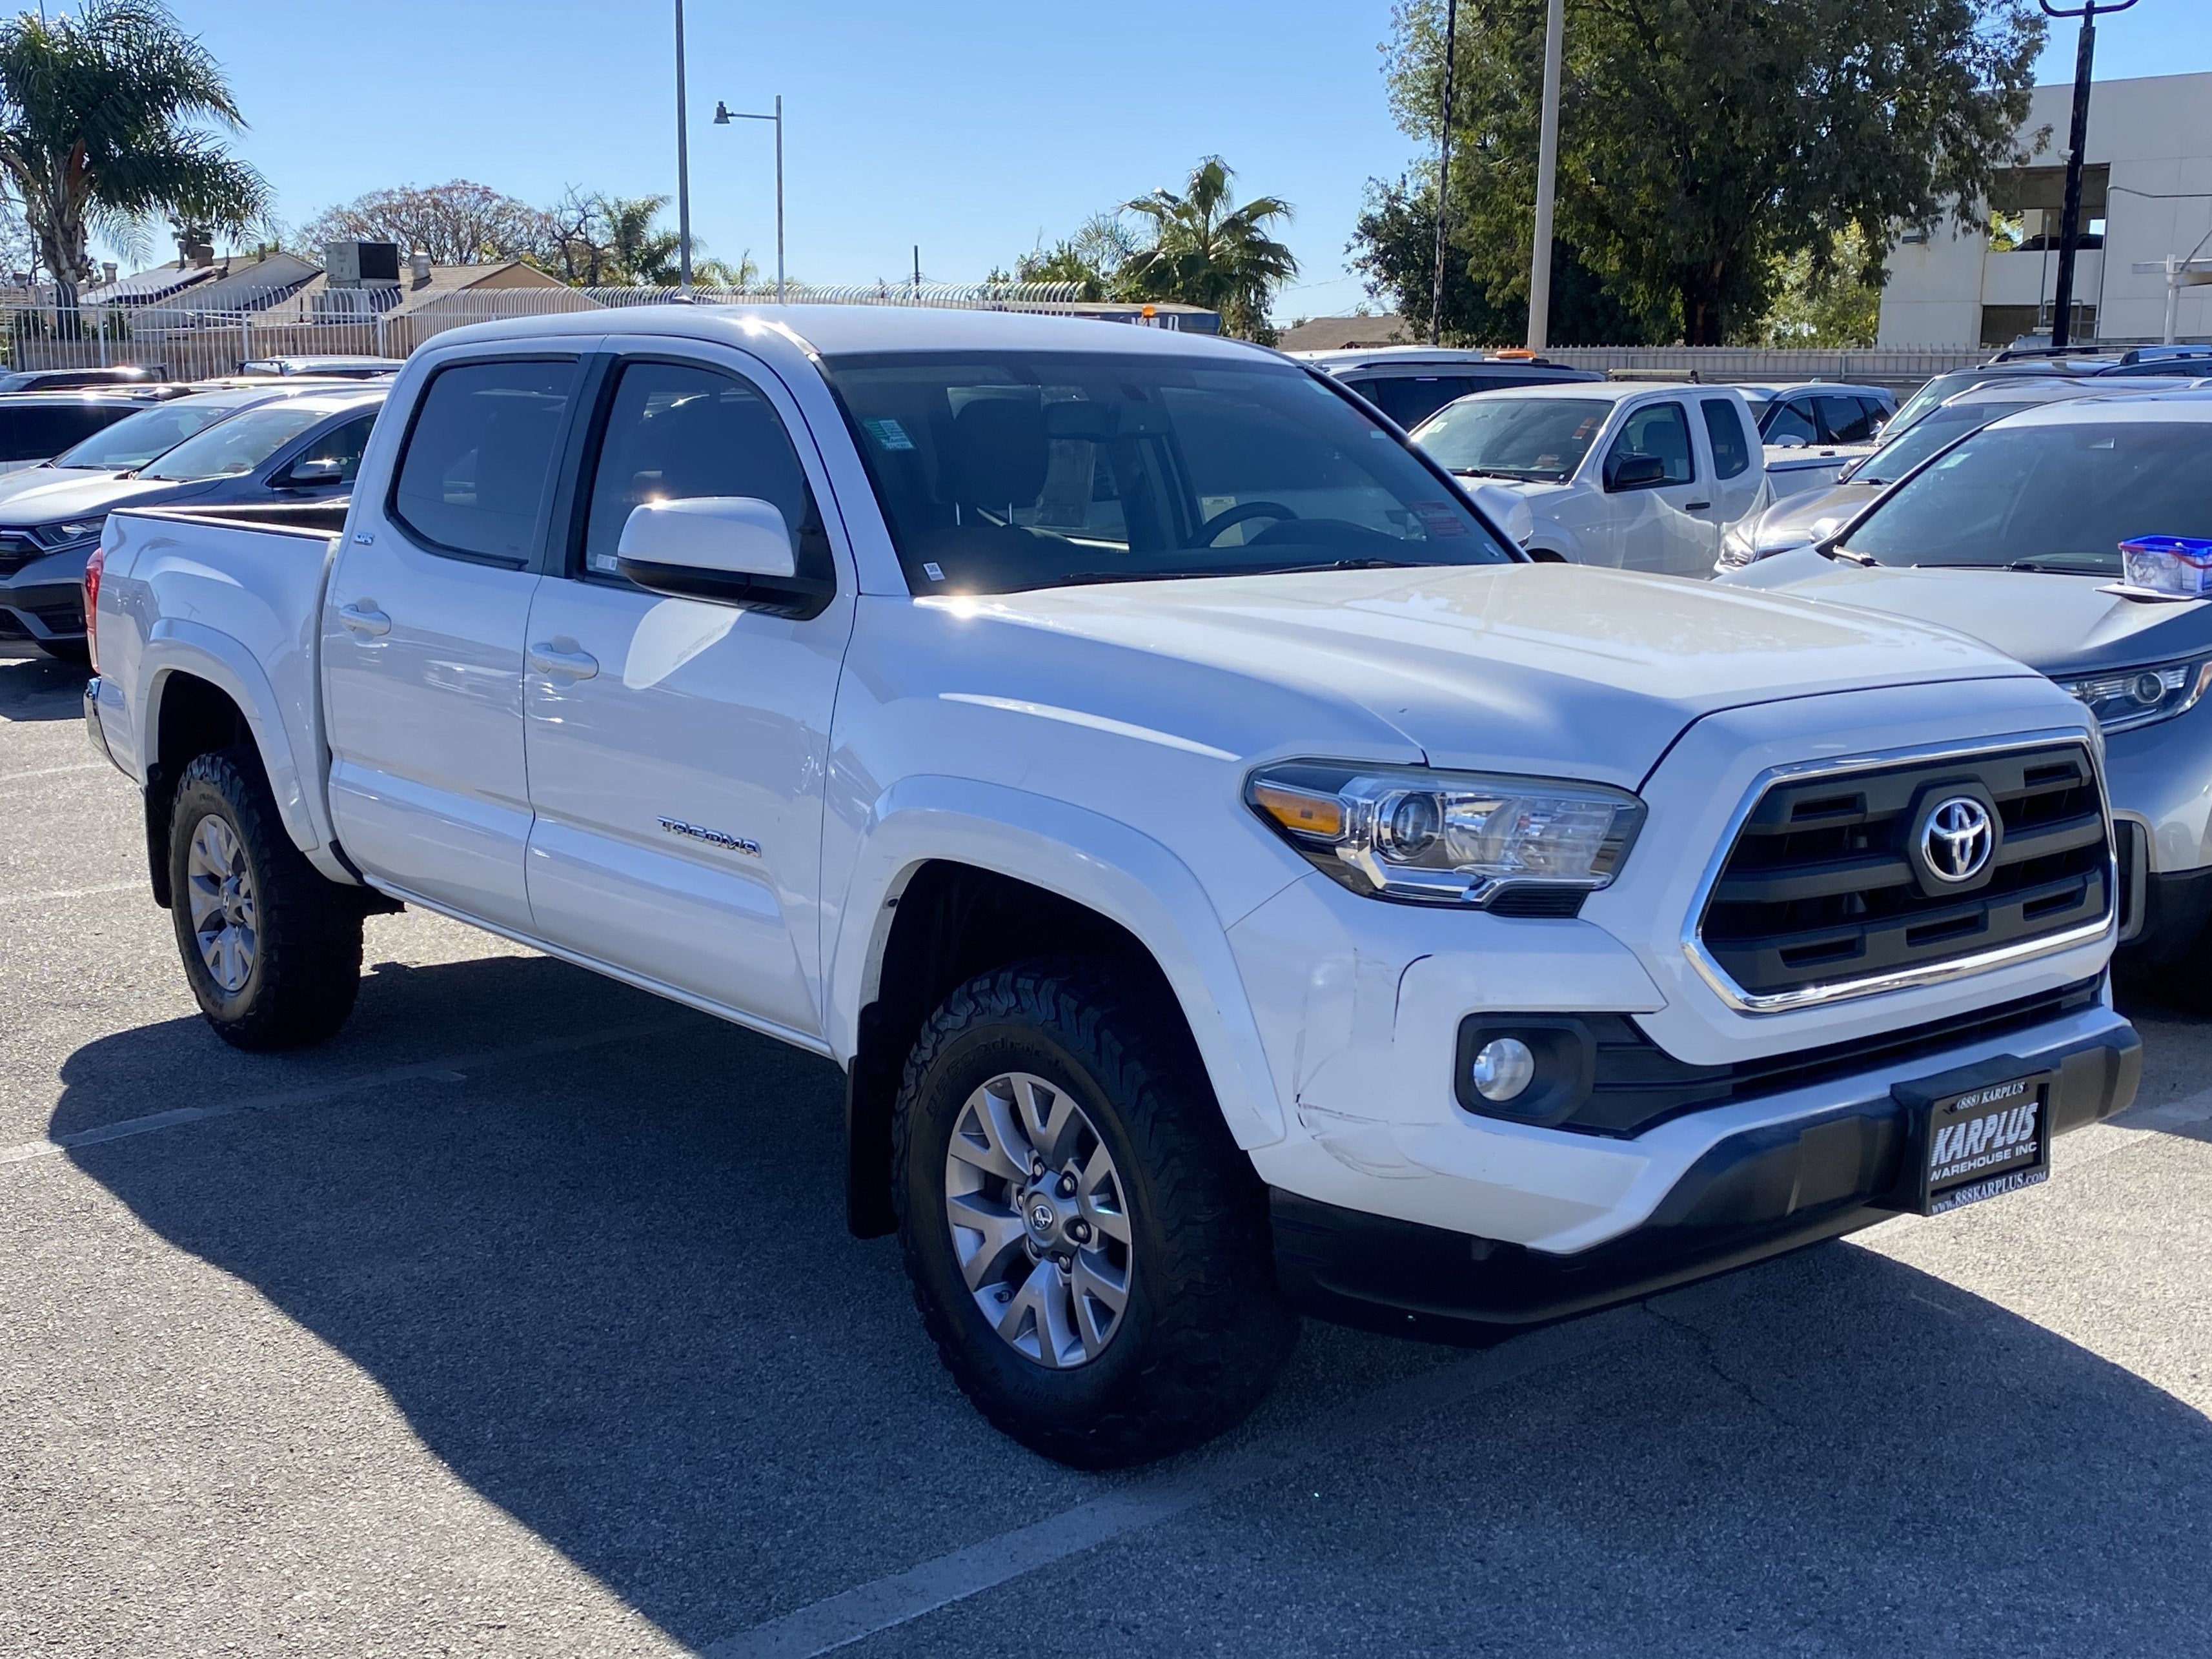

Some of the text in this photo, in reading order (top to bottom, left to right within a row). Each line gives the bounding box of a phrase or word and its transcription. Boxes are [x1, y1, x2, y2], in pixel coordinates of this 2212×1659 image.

[1956, 1081, 2025, 1110] (888) KARPLUS
[1931, 1102, 2039, 1166] KARPLUS
[1930, 1141, 2037, 1182] WAREHOUSE INC
